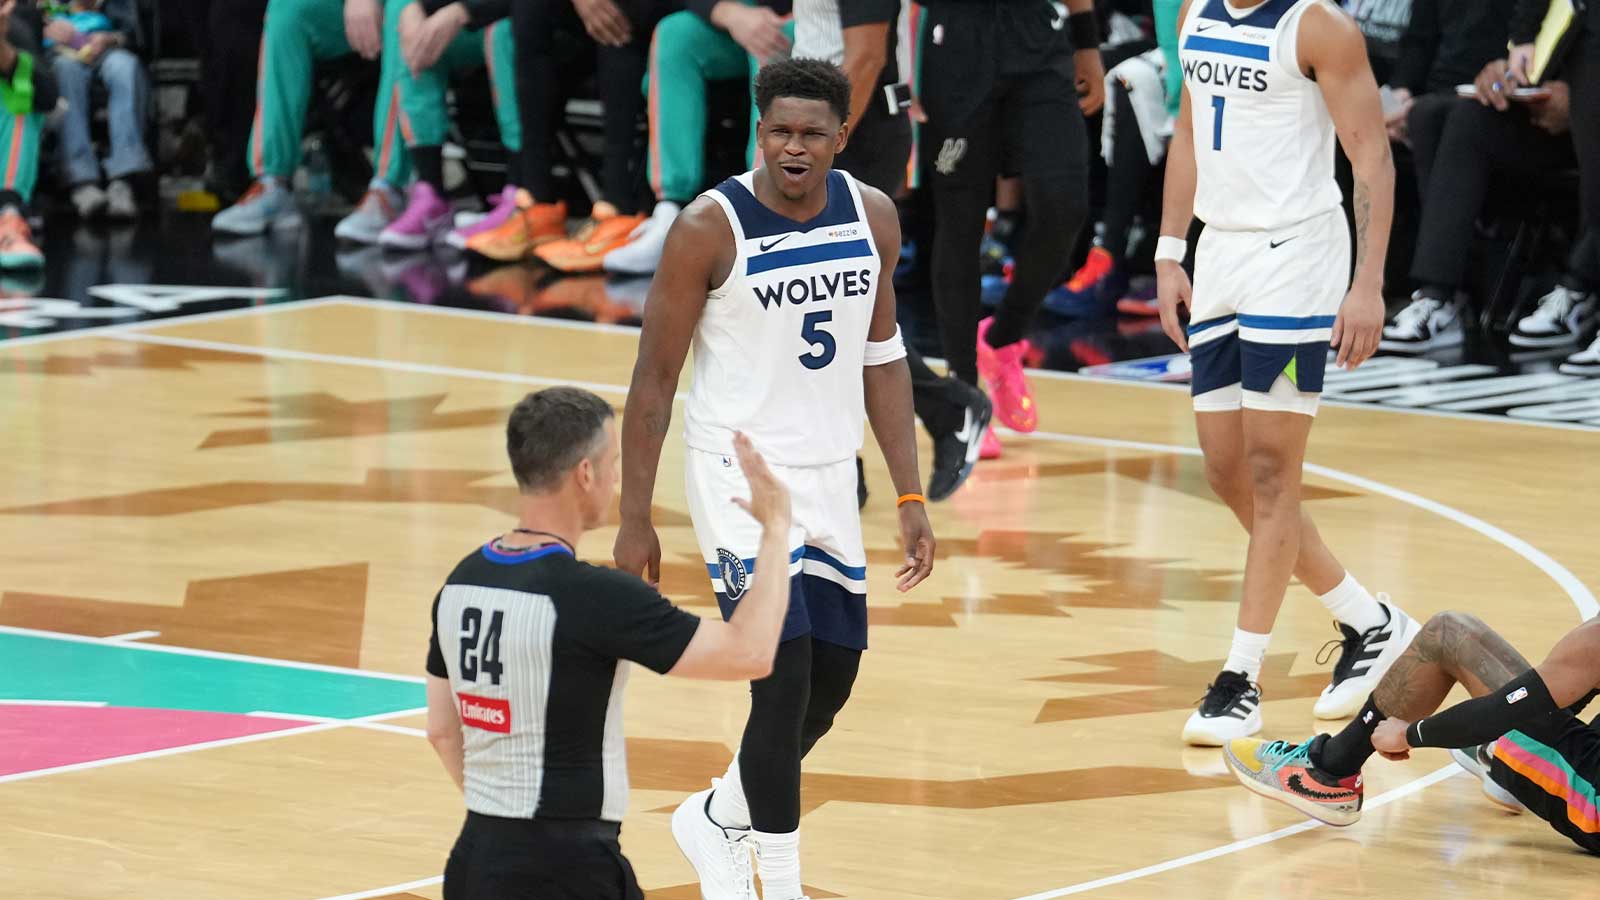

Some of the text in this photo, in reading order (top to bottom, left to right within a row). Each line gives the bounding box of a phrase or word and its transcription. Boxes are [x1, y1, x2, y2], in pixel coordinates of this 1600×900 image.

[1182, 59, 1268, 92] WOLVES
[1211, 95, 1226, 151] 1
[752, 269, 871, 311] WOLVES
[798, 310, 837, 370] 5
[459, 607, 504, 685] 24
[461, 699, 506, 725] Emirates
